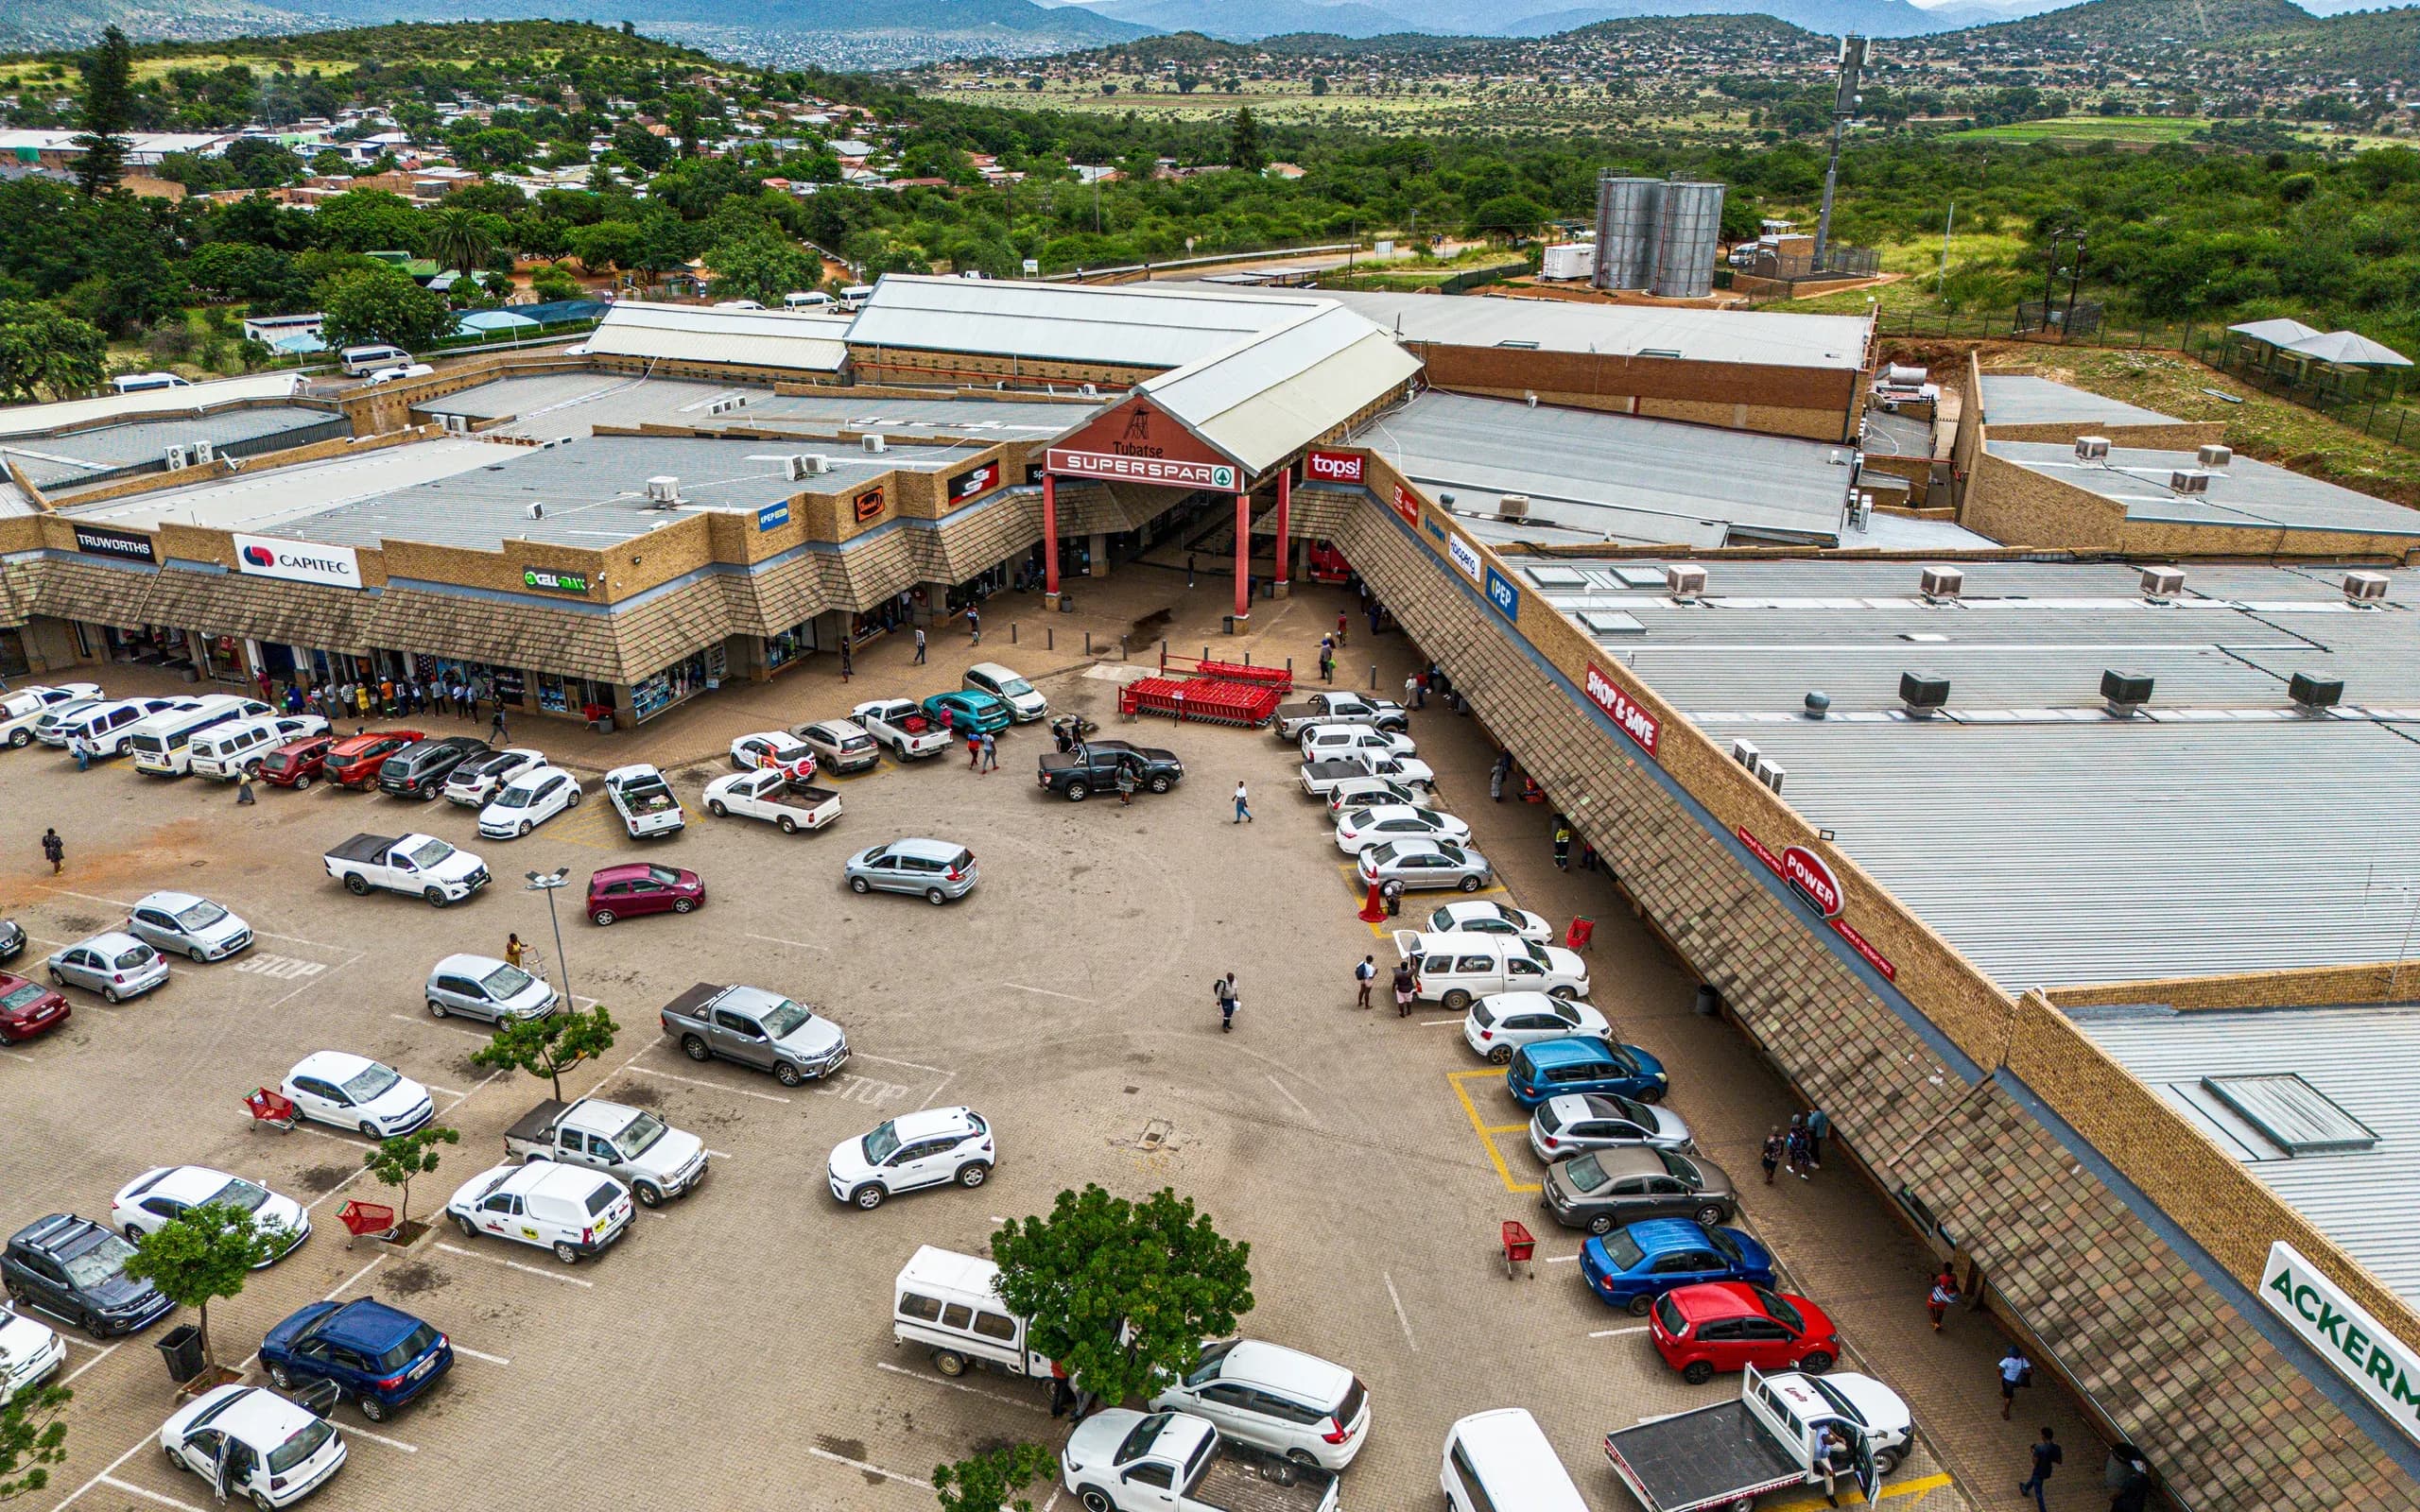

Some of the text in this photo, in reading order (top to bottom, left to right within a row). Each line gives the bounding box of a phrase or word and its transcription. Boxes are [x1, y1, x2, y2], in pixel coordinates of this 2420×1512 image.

[1113, 441, 1164, 458] Tubatse
[1067, 455, 1211, 481] SUPERSPAR
[1312, 454, 1361, 477] tops!
[77, 533, 150, 555] TRUWORTHS
[279, 554, 350, 575] CAPITEC
[1495, 578, 1512, 608] PEP
[1587, 671, 1654, 746] SHOP & SAVE
[1787, 853, 1835, 906] POWER
[233, 952, 328, 979] STOP
[816, 1073, 908, 1108] STOP
